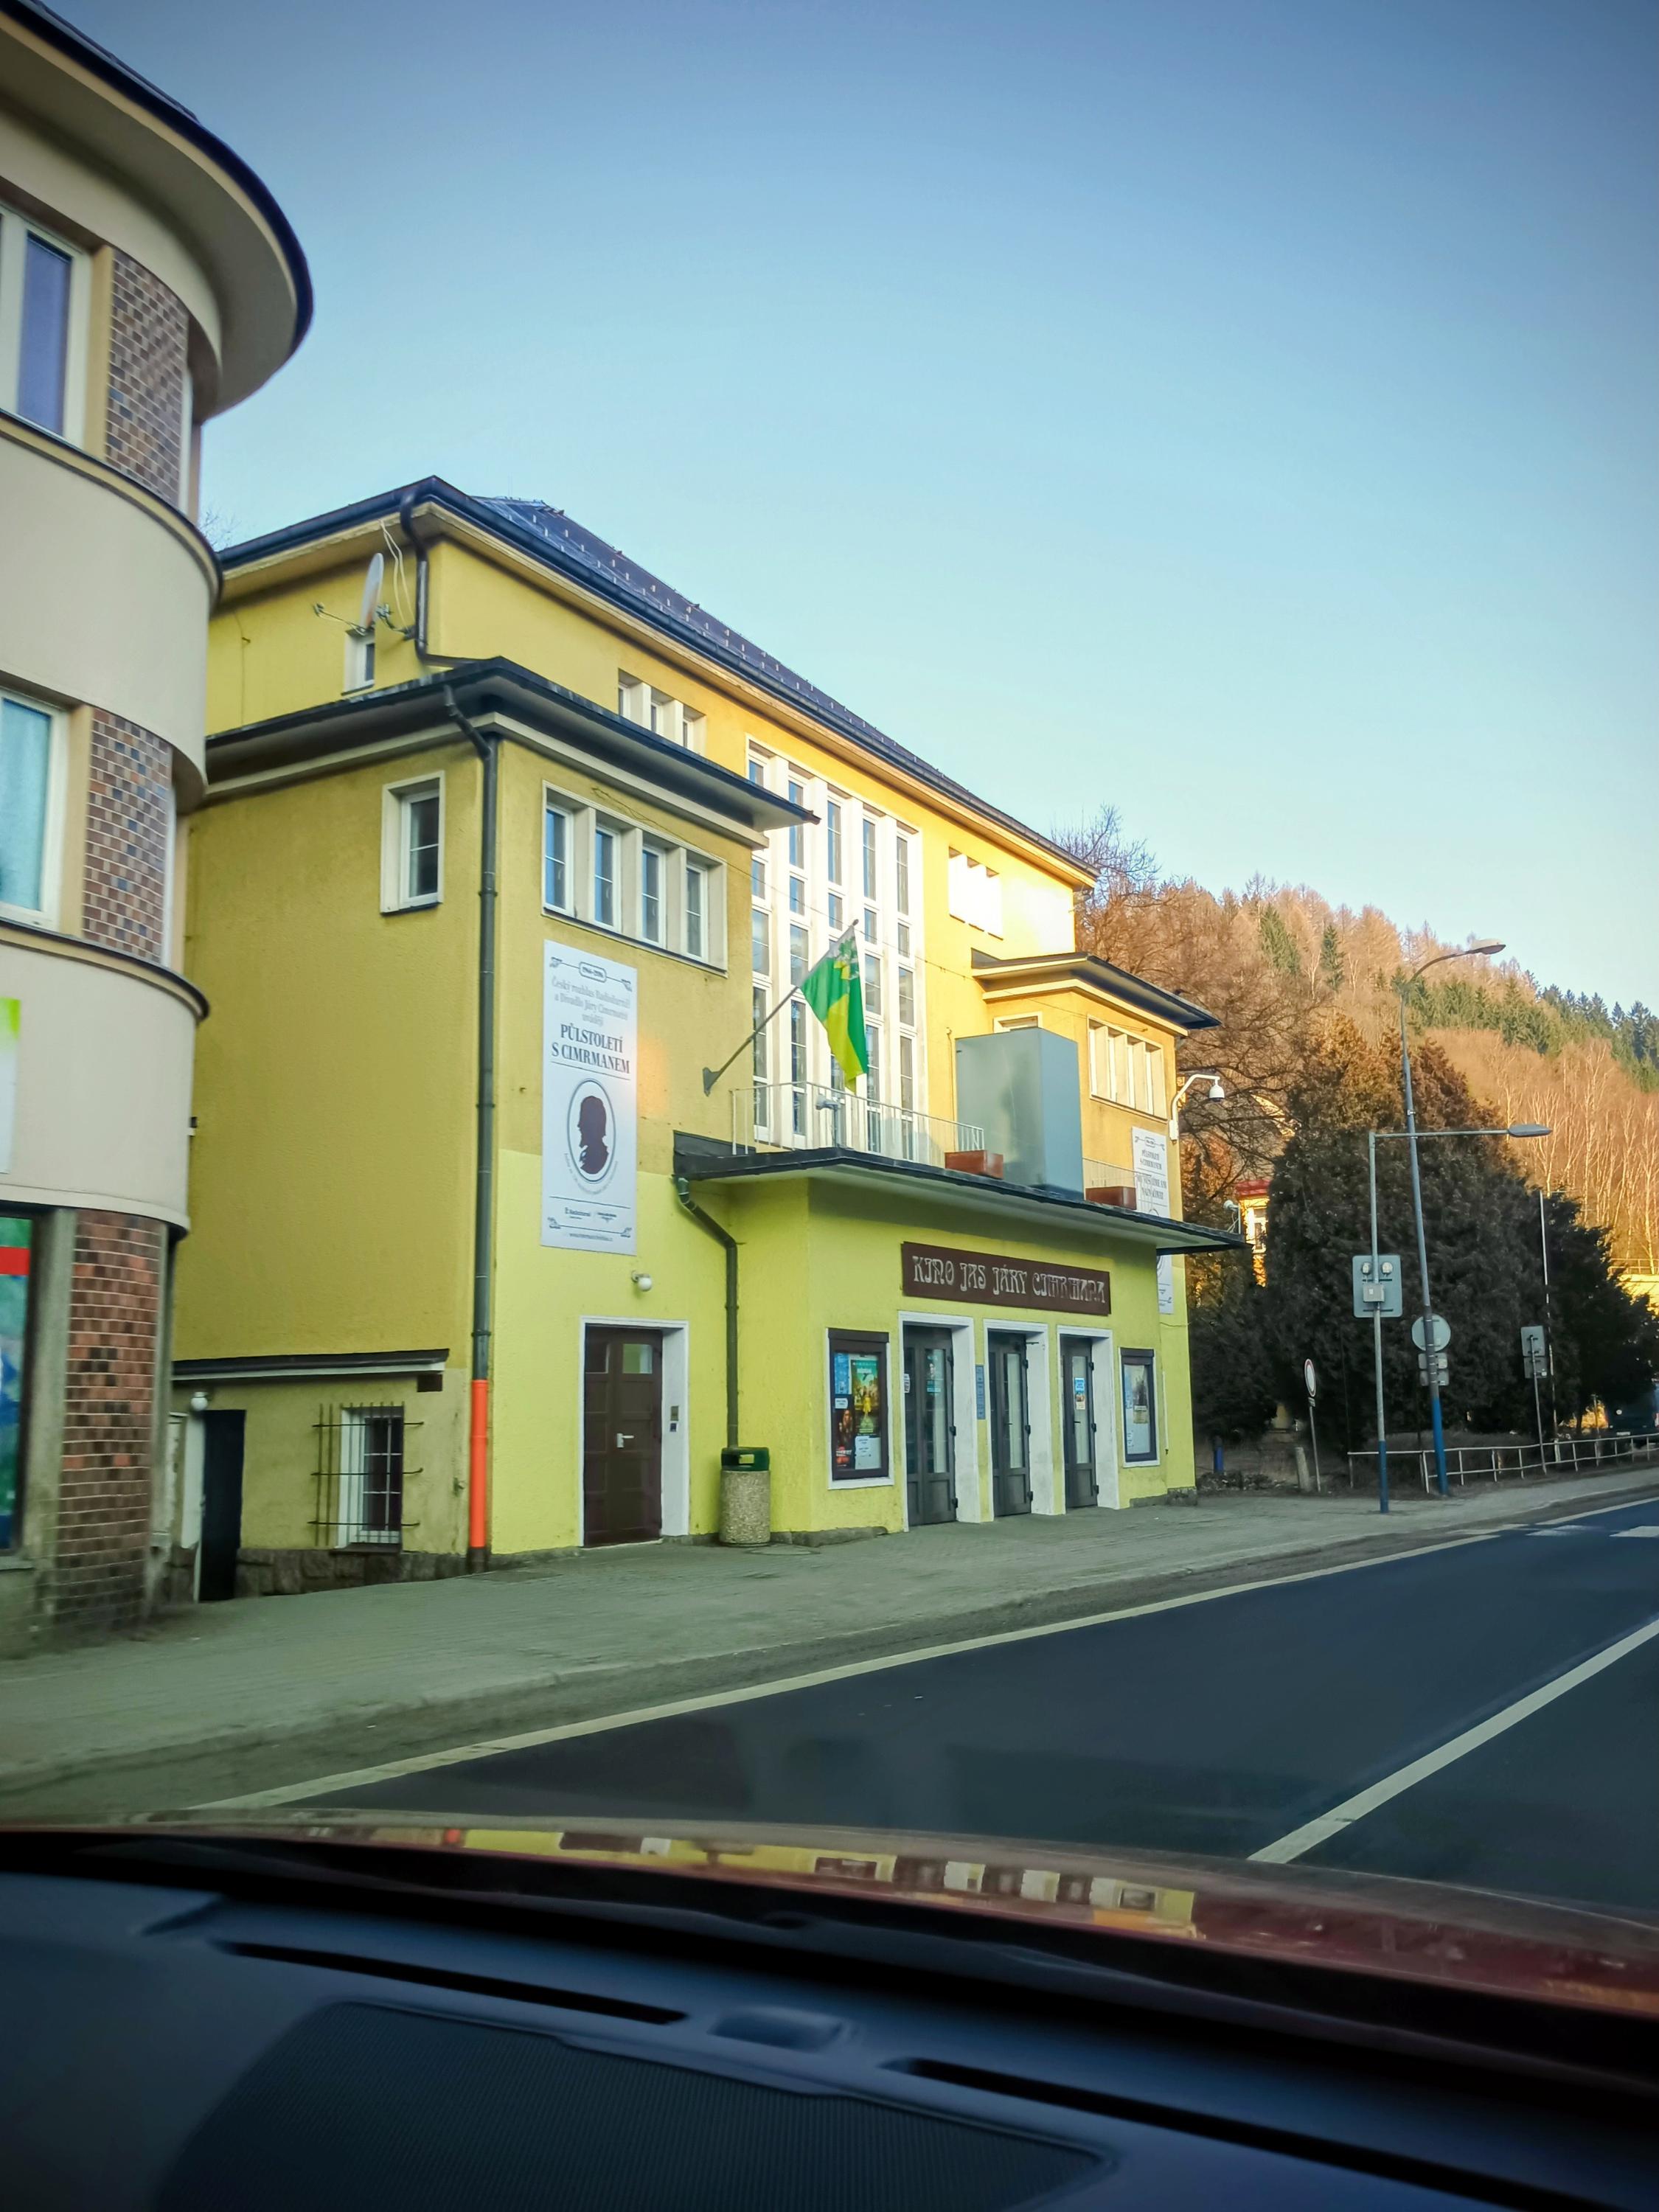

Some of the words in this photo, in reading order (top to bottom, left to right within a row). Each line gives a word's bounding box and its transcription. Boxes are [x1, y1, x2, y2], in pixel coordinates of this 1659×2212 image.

[560, 1022, 623, 1053] PŮLSTOLETÍ
[552, 1042, 559, 1057] S
[561, 1044, 630, 1074] CIMRMANEM
[912, 1256, 954, 1285] KINO
[959, 1262, 986, 1292] JAS
[992, 1264, 1027, 1295] JÁRY
